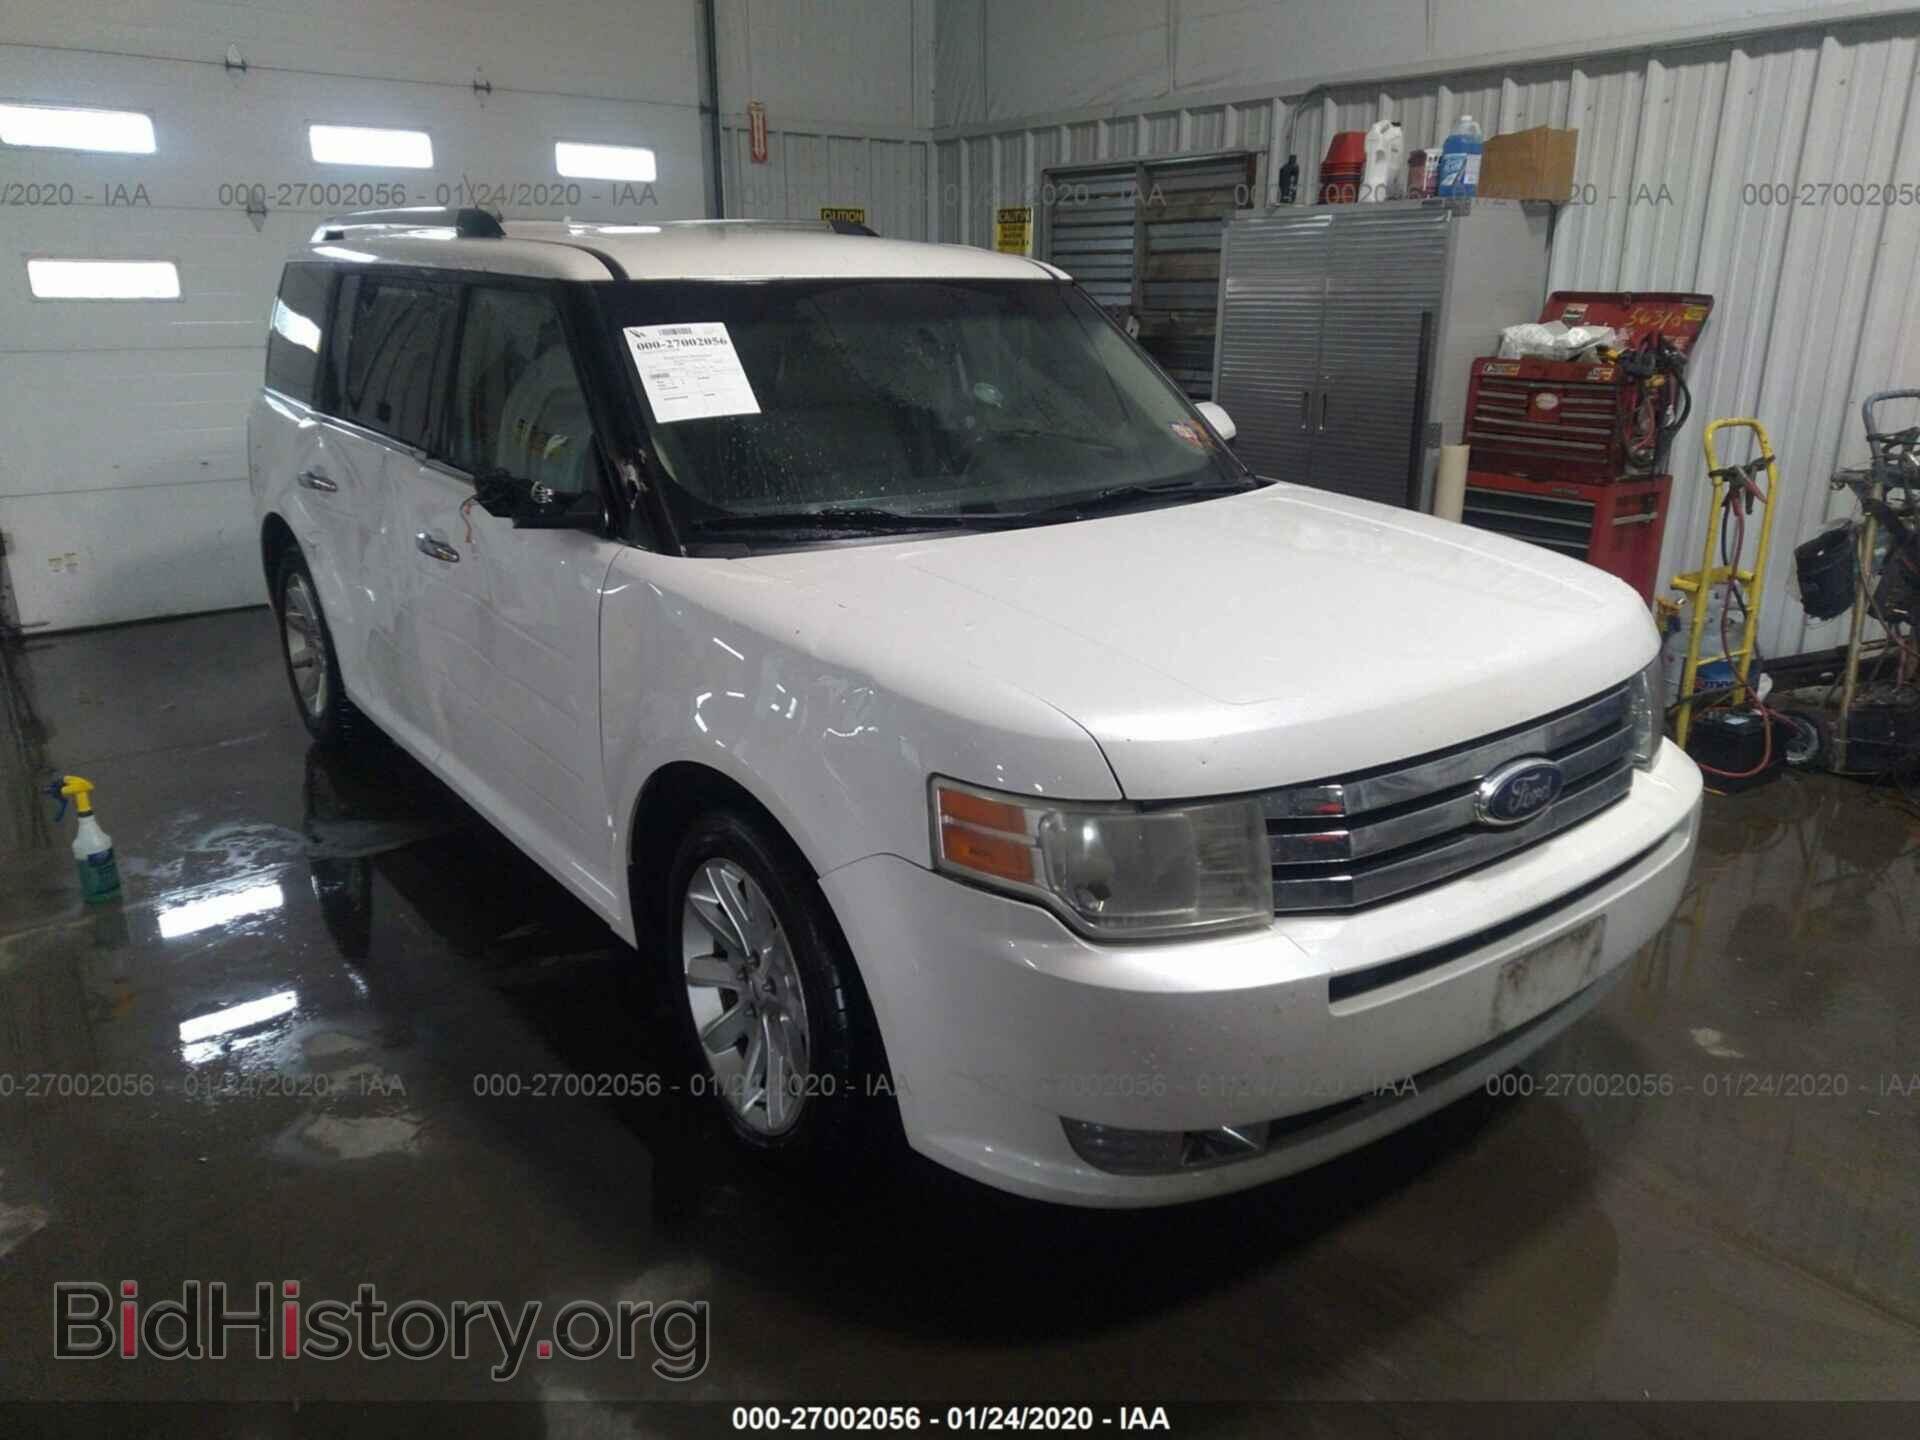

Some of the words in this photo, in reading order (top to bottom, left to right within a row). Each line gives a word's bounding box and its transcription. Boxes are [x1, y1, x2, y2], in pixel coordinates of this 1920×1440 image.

[998, 209, 1031, 223] CAUT
[636, 336, 728, 352] 000-27002056
[1508, 773, 1553, 814] Ford
